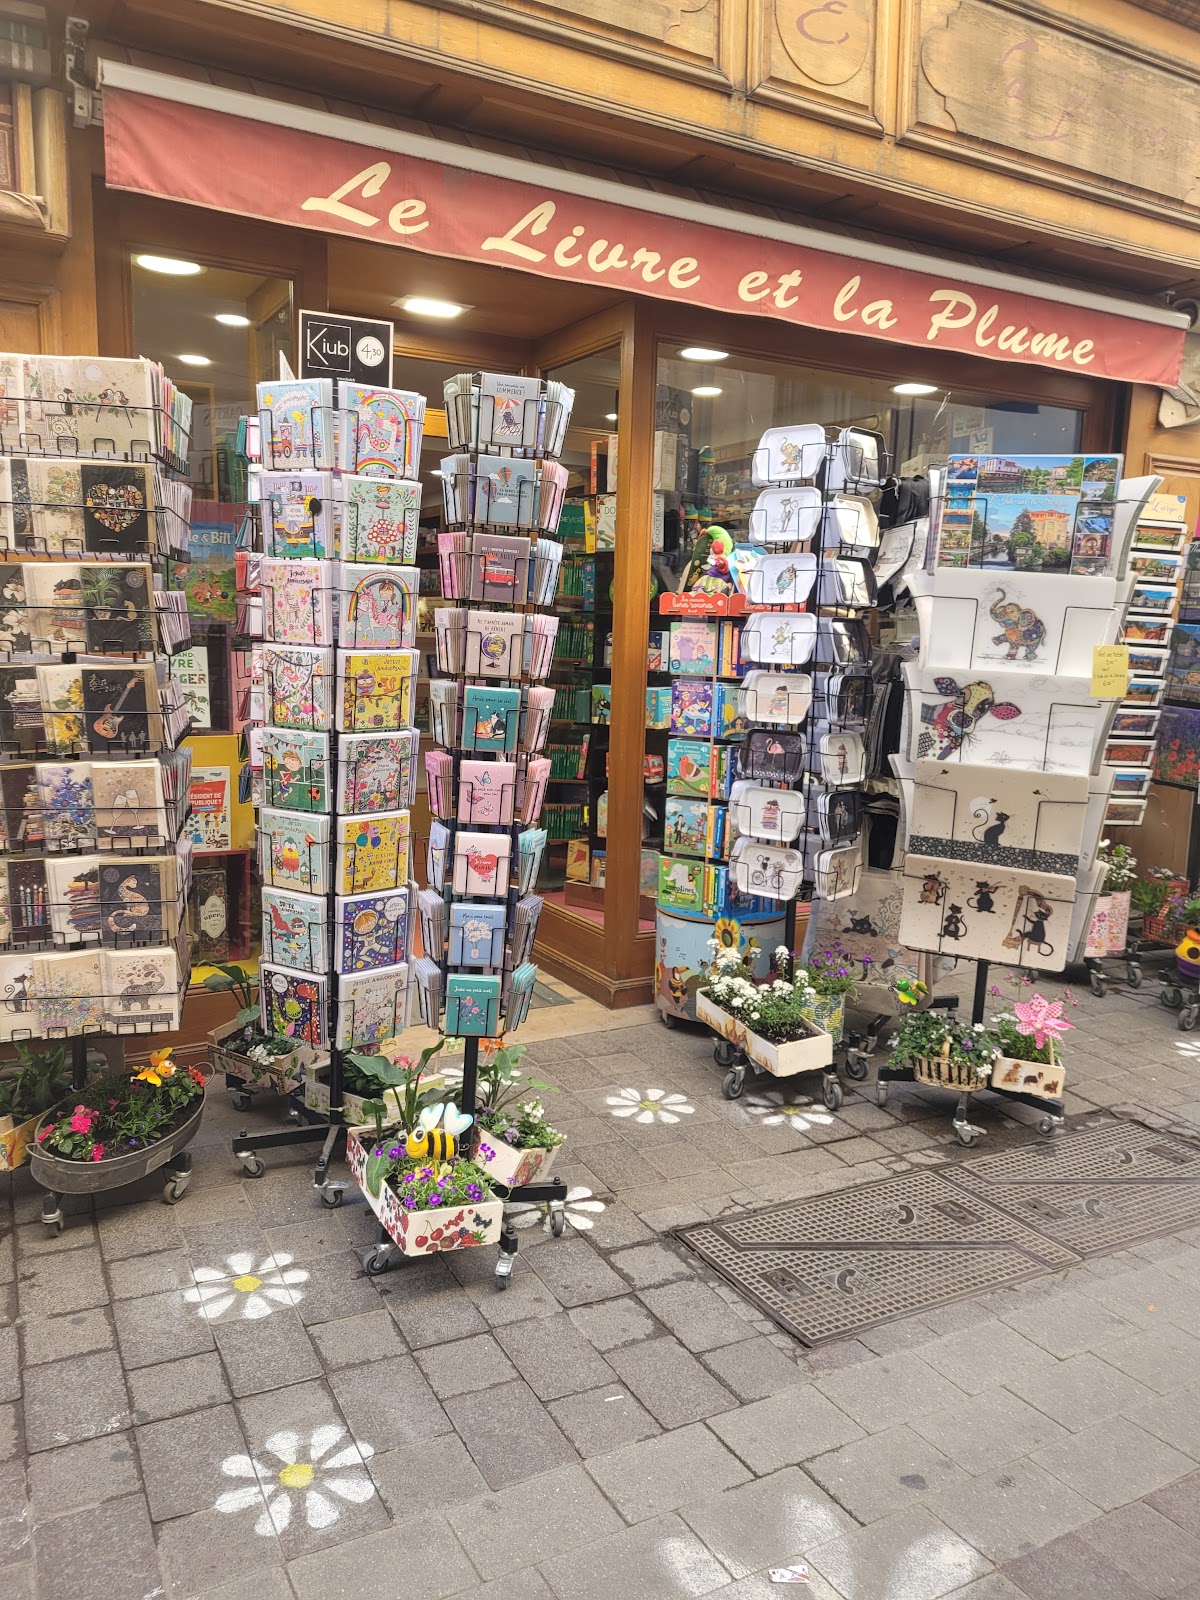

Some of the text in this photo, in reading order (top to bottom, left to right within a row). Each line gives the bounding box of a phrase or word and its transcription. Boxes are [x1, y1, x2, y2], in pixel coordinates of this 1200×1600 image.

[300, 161, 1096, 366] Le Livre et la Plume
[306, 327, 382, 366] Kiub 4,30
[604, 506, 616, 515] DO
[210, 531, 231, 544] Bill
[171, 659, 193, 668] VRE
[665, 885, 695, 894] comptines
